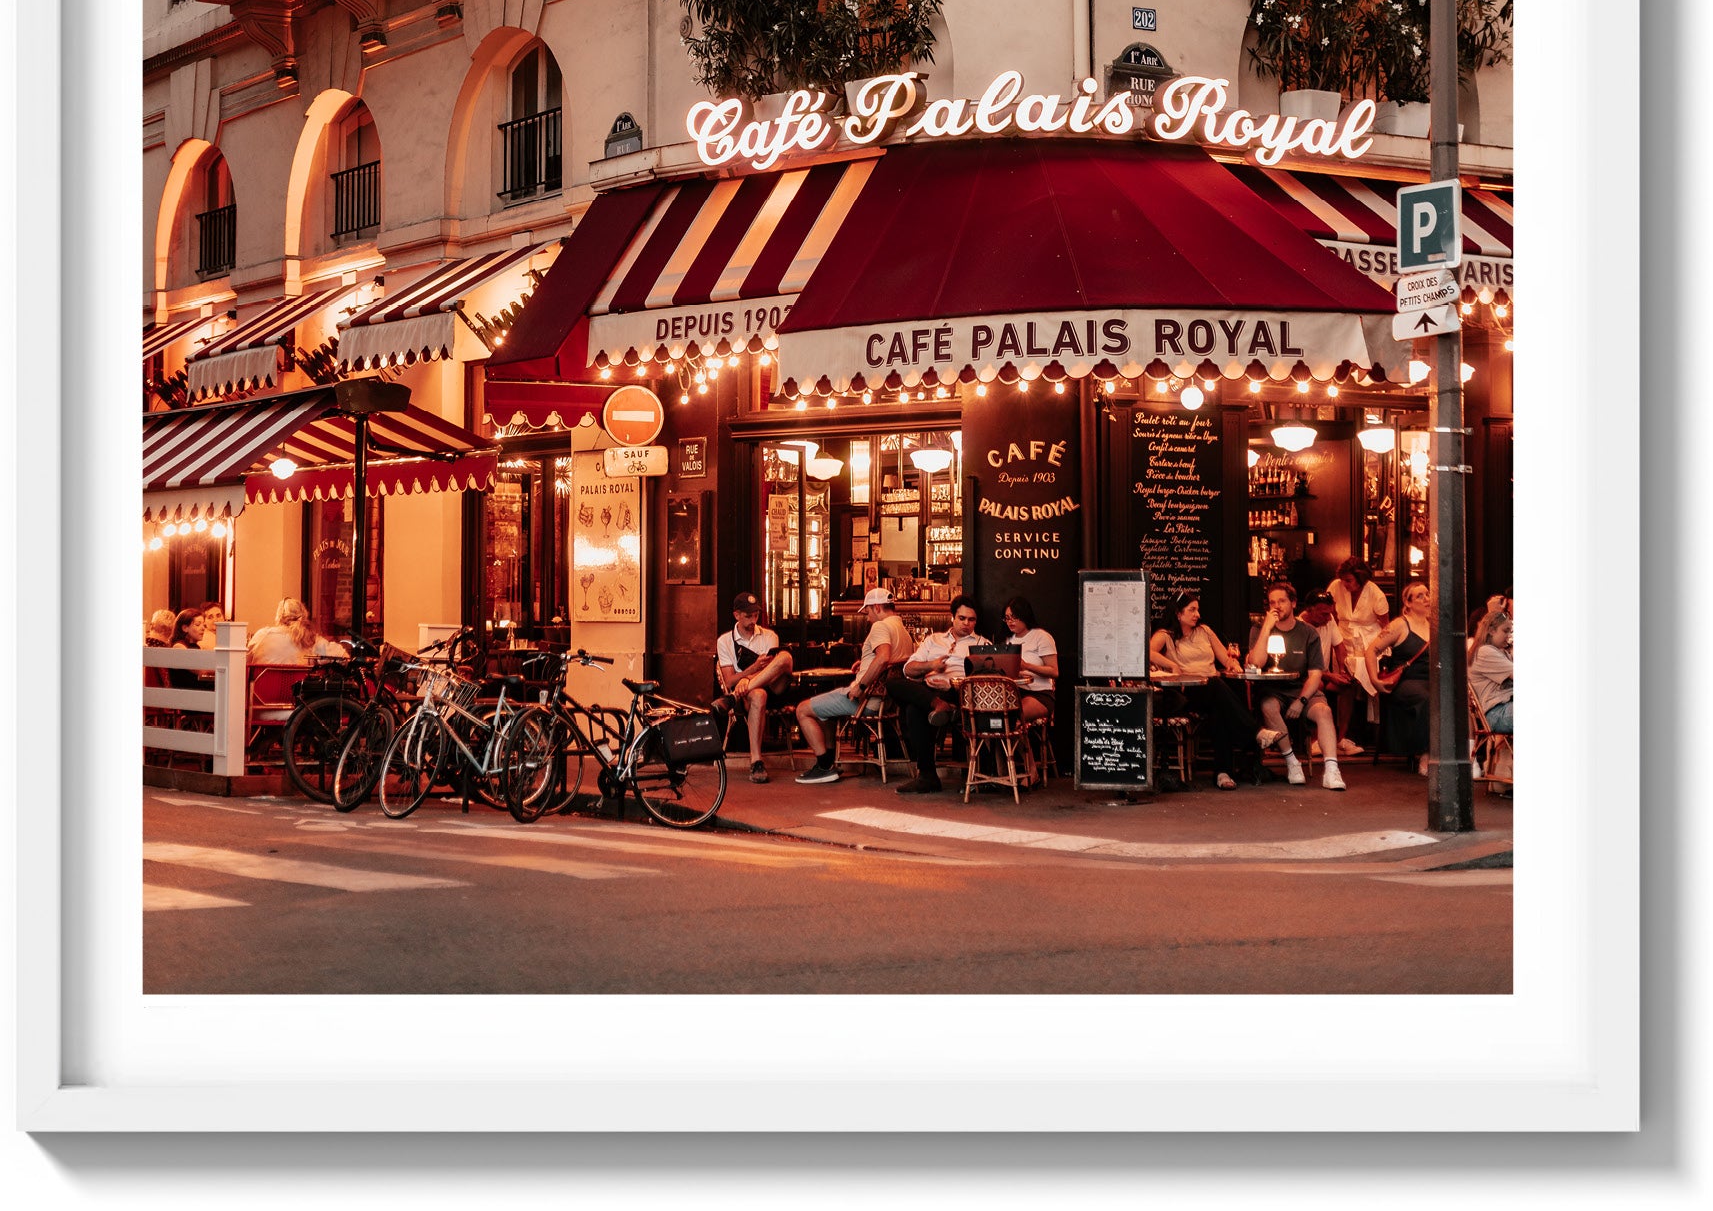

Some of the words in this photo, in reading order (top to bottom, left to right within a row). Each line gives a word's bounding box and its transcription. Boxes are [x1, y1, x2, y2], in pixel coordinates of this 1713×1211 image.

[1135, 11, 1155, 28] 202
[1130, 76, 1156, 92] RUE
[686, 89, 832, 171] Café
[845, 70, 1135, 145] Palais
[1154, 76, 1376, 166] Royal
[1413, 201, 1438, 254] P
[1462, 260, 1513, 286] ARIS
[1407, 279, 1426, 292] CROIX
[1426, 276, 1439, 288] DES
[1400, 293, 1422, 308] PETITS
[1423, 285, 1456, 303] CHAMPS
[655, 311, 735, 341] DEPUIS
[865, 322, 954, 369] CAFÉ
[971, 319, 1132, 361] PALAIS
[1155, 318, 1304, 358] ROYAL
[1134, 411, 1160, 425] Poulet
[1190, 415, 1213, 432] four
[1133, 427, 1155, 438] Souris
[623, 449, 650, 459] SAUF
[685, 444, 699, 455] RUE
[987, 440, 1067, 468] CAFÉ
[1148, 441, 1169, 457] Confit
[1174, 444, 1197, 453] canard
[682, 460, 703, 472] VALOIS
[1149, 455, 1173, 467] Tartare
[1265, 452, 1289, 467] Vente
[998, 472, 1030, 488] Depuis
[1032, 472, 1056, 483] 1903
[1174, 470, 1201, 482] boucher
[580, 484, 607, 495] PALAIS
[609, 482, 634, 494] ROYAL
[1133, 482, 1157, 498] Royal
[1200, 486, 1220, 499] burger
[978, 497, 1030, 521] PALAIS
[1031, 496, 1080, 521] ROYAL
[1163, 522, 1175, 533] Les
[995, 532, 1061, 543] SERVICE
[995, 548, 1060, 560] CONTINU
